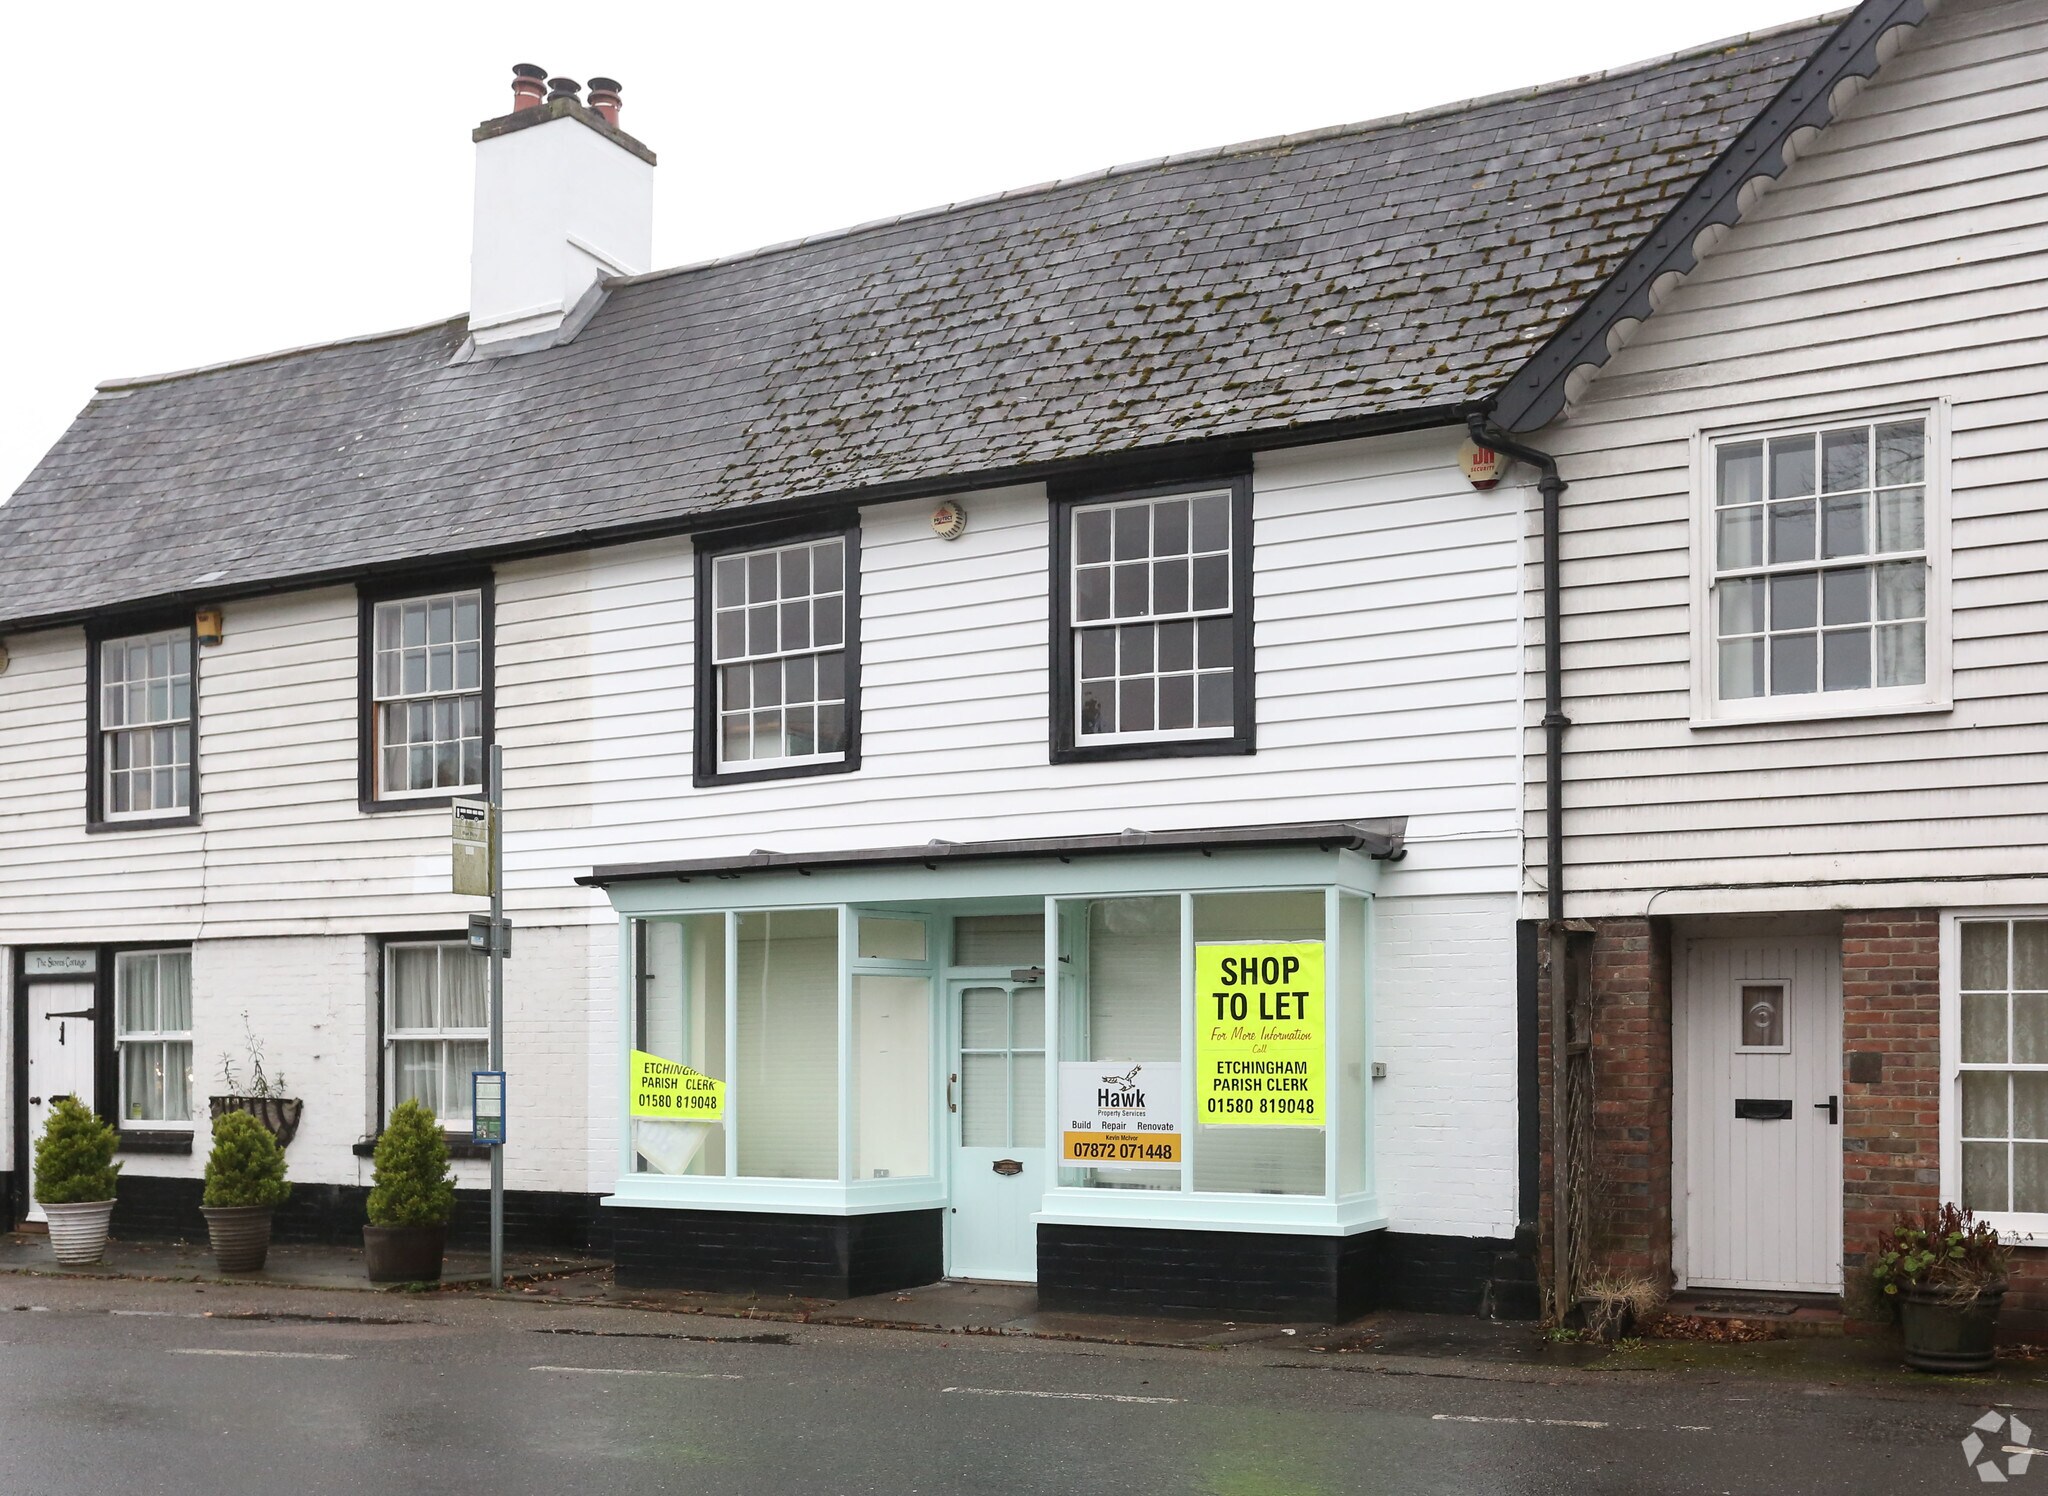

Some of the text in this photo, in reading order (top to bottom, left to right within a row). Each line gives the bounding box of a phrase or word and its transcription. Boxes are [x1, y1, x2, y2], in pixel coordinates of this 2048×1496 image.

[37, 958, 47, 968] The
[1221, 956, 1300, 986] SHOP
[1212, 992, 1309, 1021] TO LET
[1211, 1027, 1312, 1041] For More Information
[1252, 1044, 1267, 1054] Call
[645, 1062, 703, 1076] ETCHING
[1217, 1061, 1307, 1074] ETCHINGHAM
[642, 1077, 716, 1090] PARISH CLERK
[1214, 1078, 1308, 1091] PARISH CLERK
[639, 1094, 717, 1109] 01580 819048
[1098, 1089, 1145, 1108] Hawk
[1208, 1098, 1314, 1114] 01580 819048
[1098, 1110, 1121, 1118] Property
[1072, 1121, 1174, 1131] Build Repair Renovate
[1074, 1143, 1172, 1159] 07872 071448
